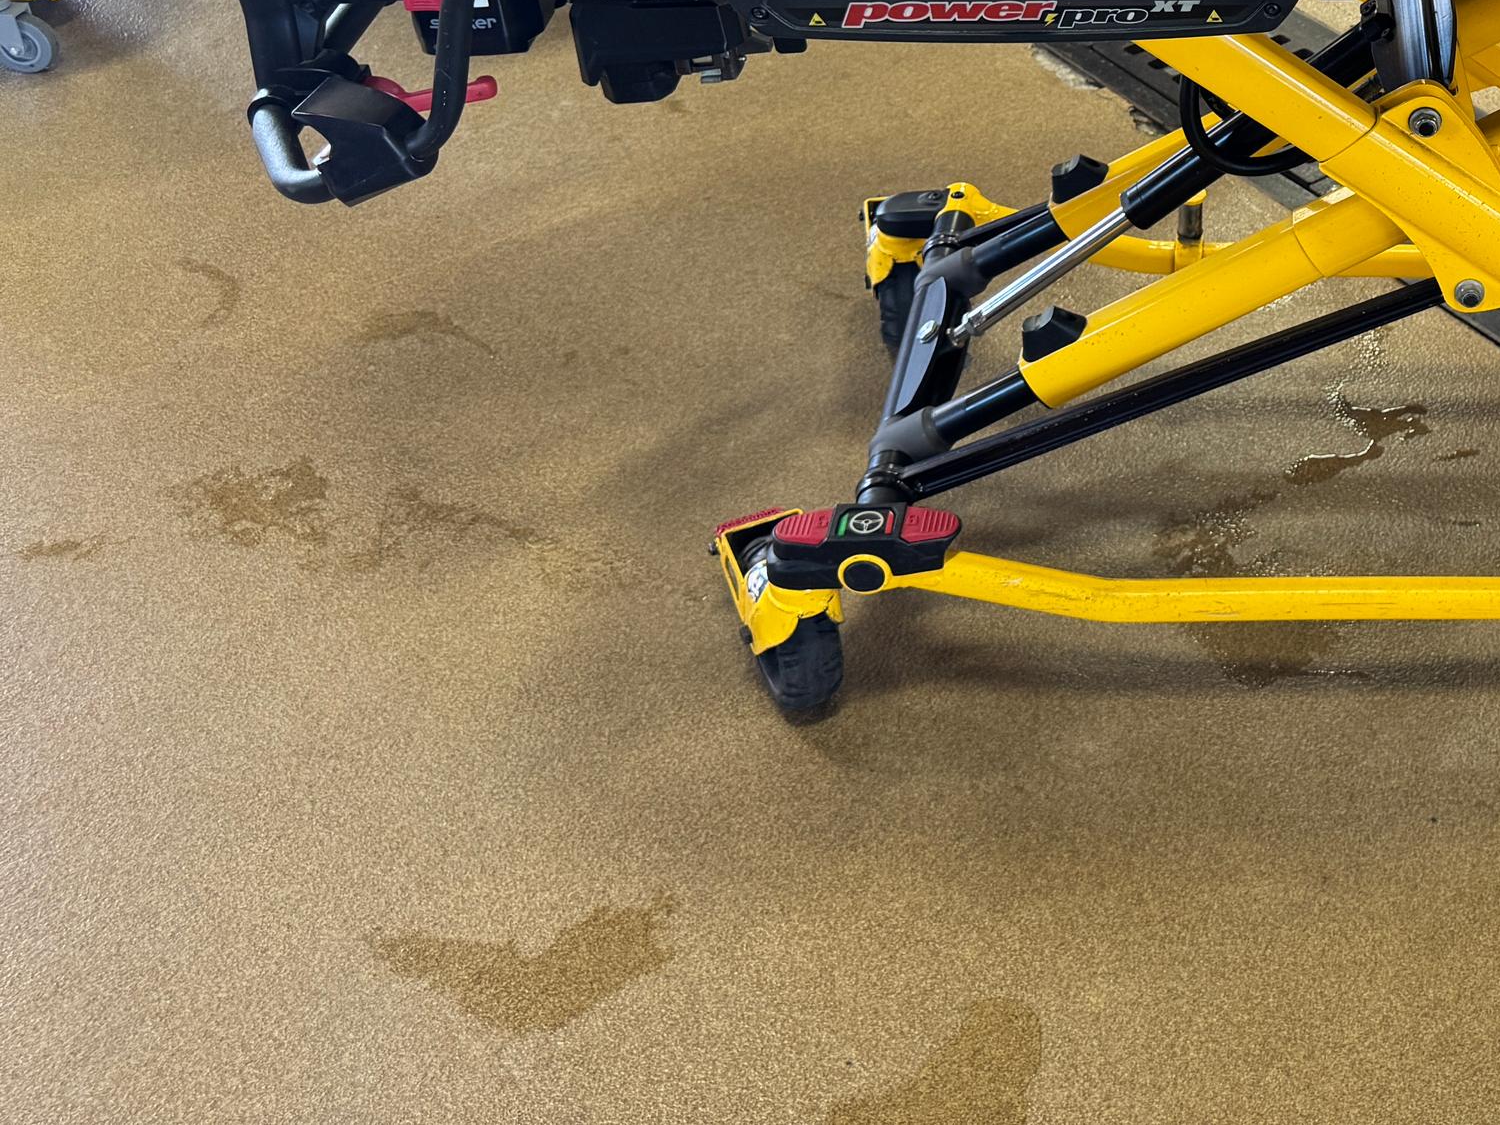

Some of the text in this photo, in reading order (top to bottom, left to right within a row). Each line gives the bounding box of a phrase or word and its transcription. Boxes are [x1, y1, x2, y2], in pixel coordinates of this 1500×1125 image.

[840, 0, 1201, 29] power pro XT
